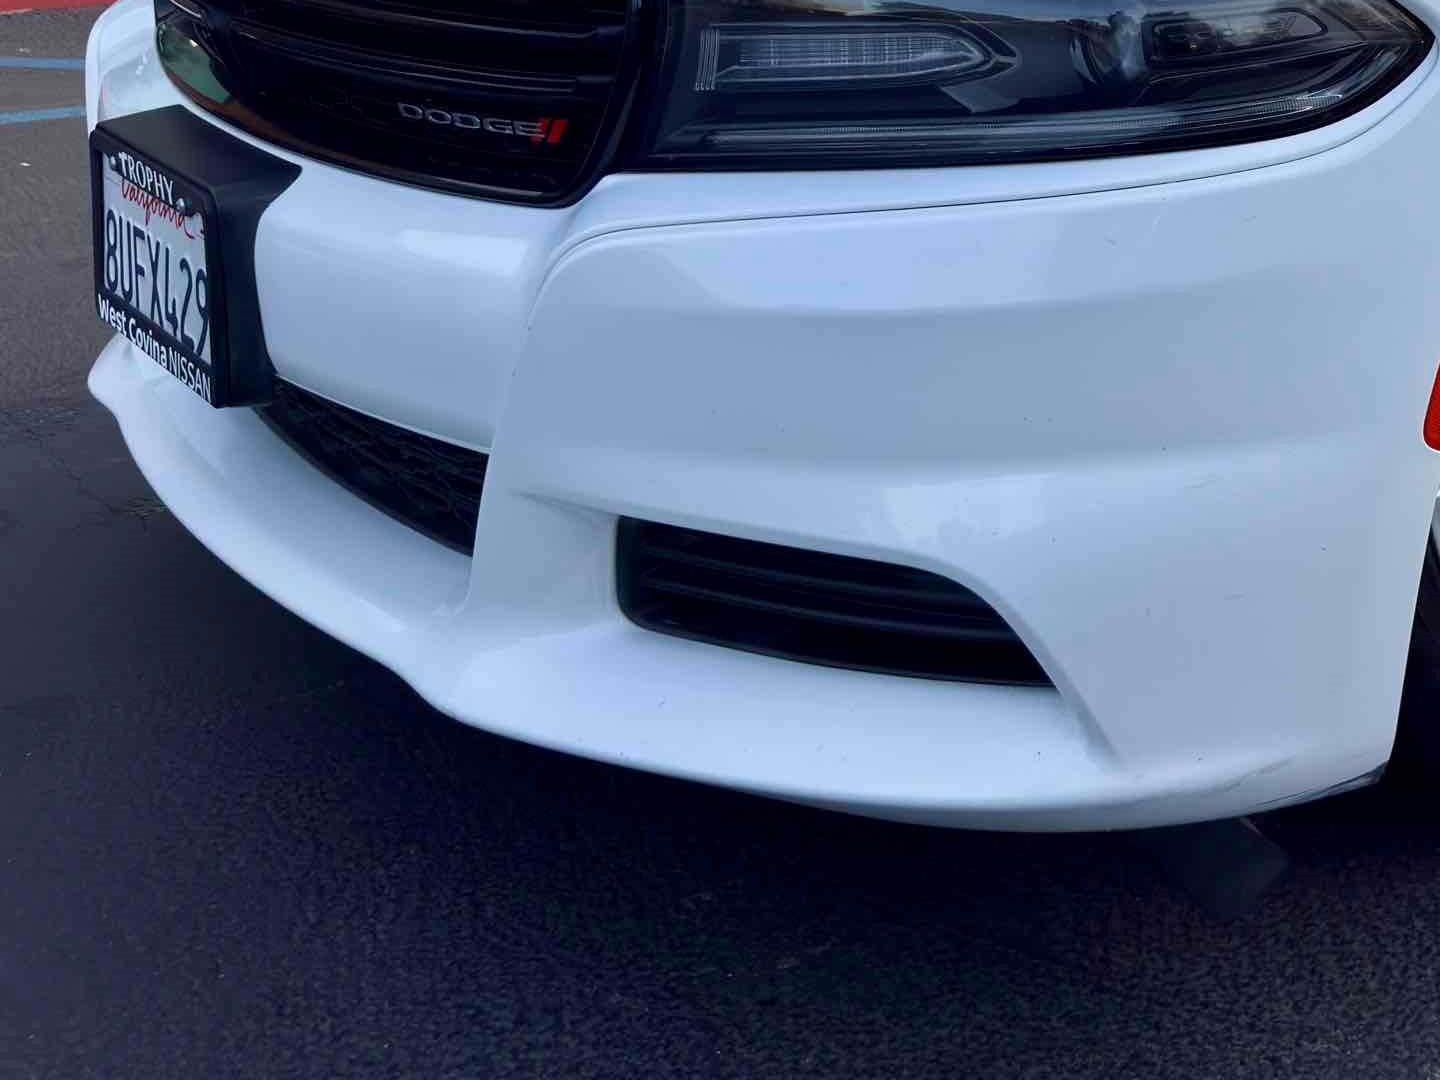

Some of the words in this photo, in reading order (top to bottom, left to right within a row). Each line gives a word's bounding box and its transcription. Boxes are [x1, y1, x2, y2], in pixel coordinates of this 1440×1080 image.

[398, 103, 547, 138] DODGE
[118, 151, 174, 206] TROPHY
[105, 208, 210, 358] 8UFX429
[98, 293, 127, 337] West
[129, 317, 168, 369] Covina
[168, 346, 212, 404] NISSAN
